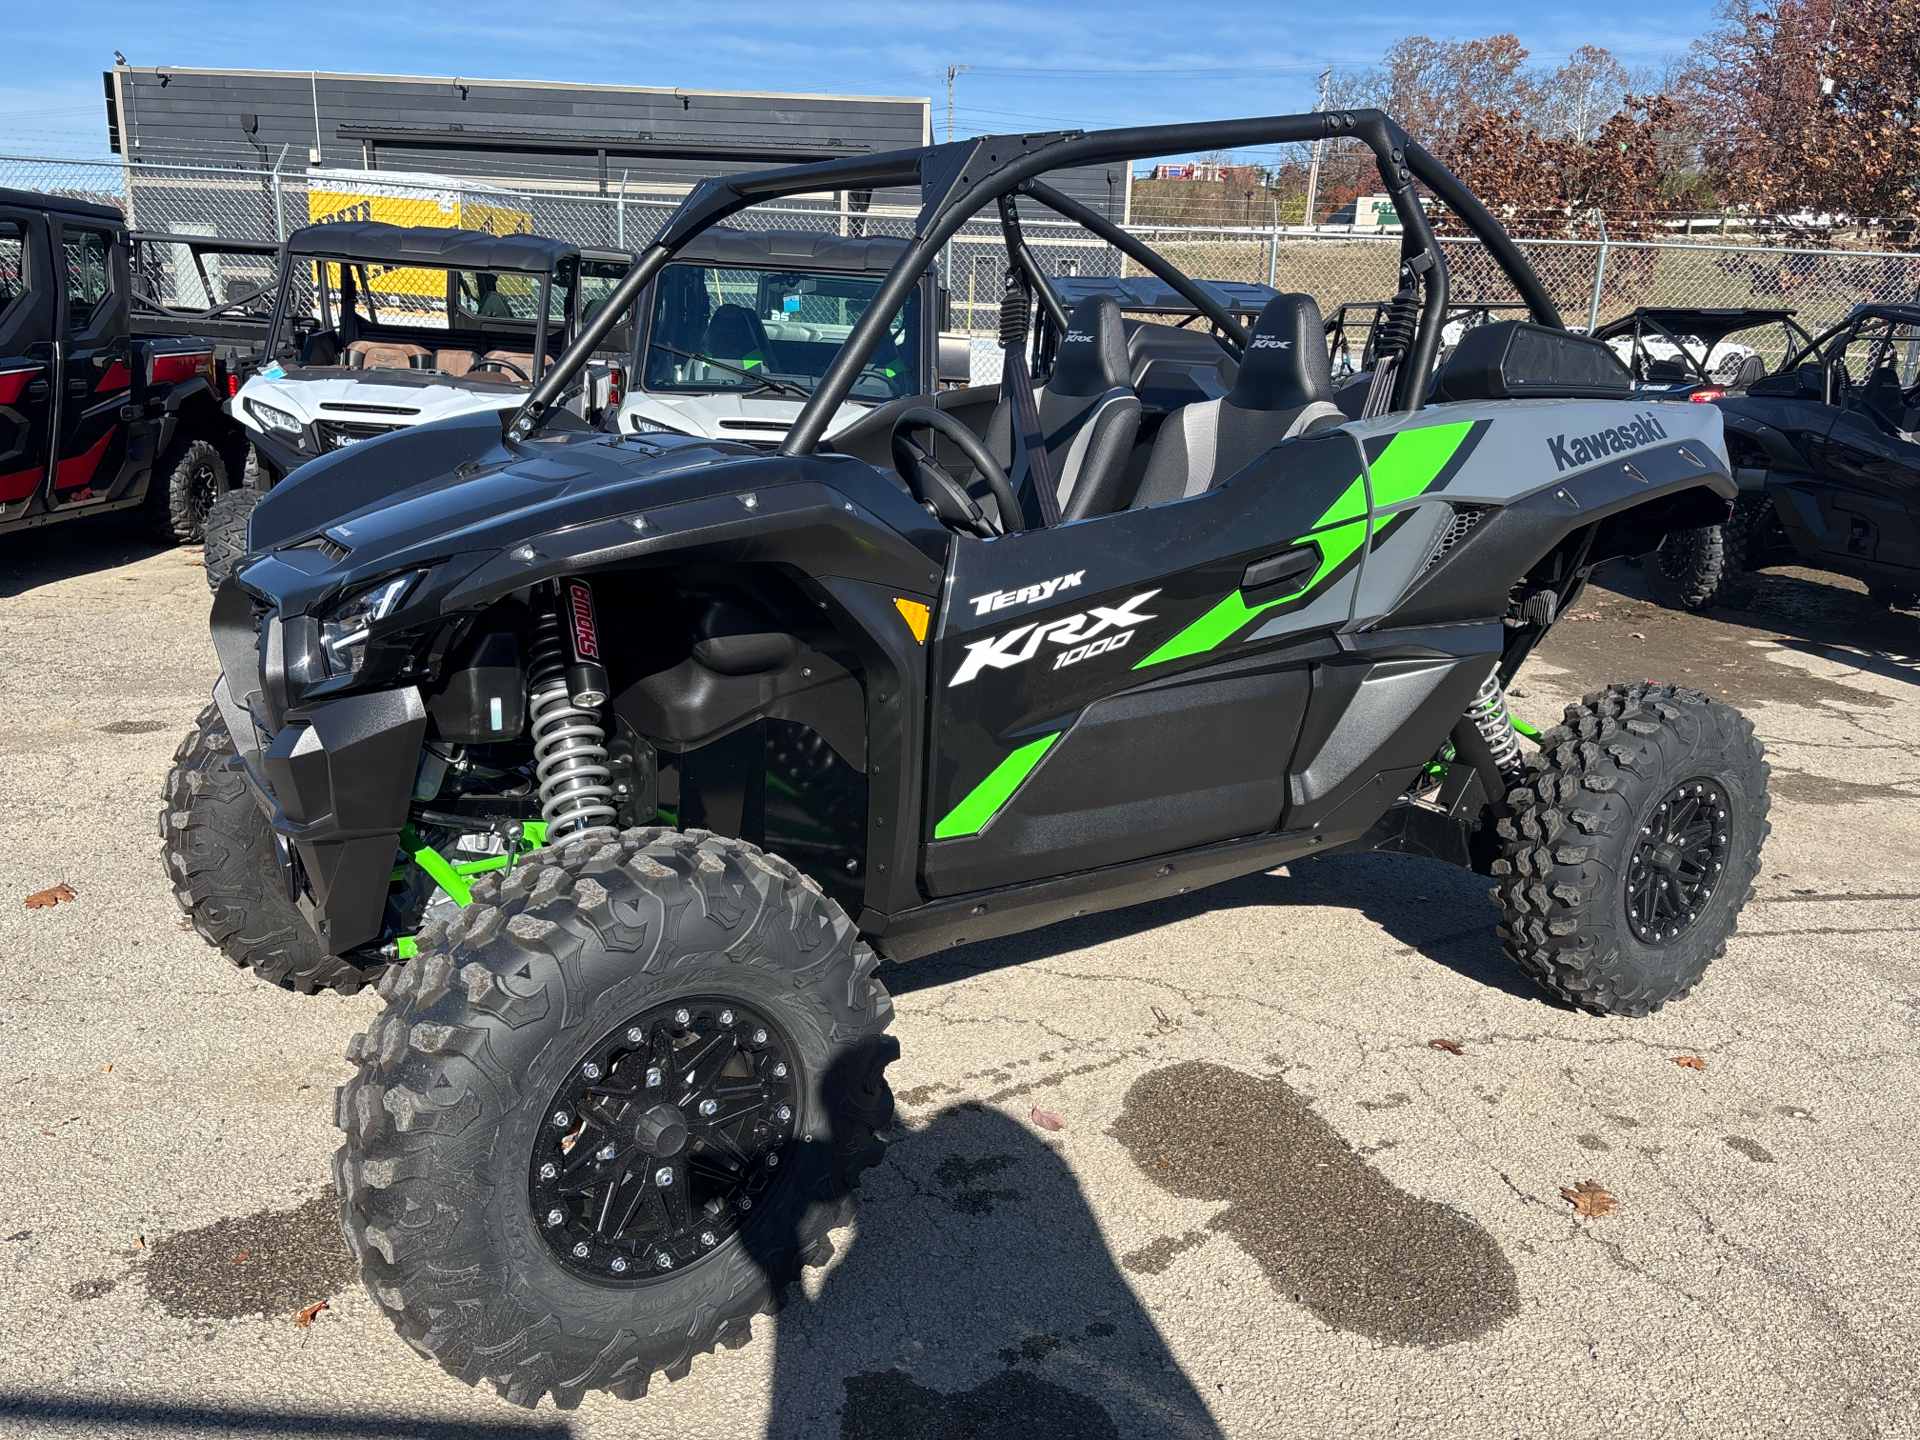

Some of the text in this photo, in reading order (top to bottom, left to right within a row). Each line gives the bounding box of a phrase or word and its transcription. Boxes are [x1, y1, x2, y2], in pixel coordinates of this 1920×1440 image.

[1064, 335, 1095, 343] KRX
[1250, 340, 1292, 349] KRX
[1546, 411, 1669, 472] Kawasaki
[570, 585, 600, 660] SHOWA
[948, 588, 1163, 688] KRX
[1052, 629, 1135, 670] 1000
